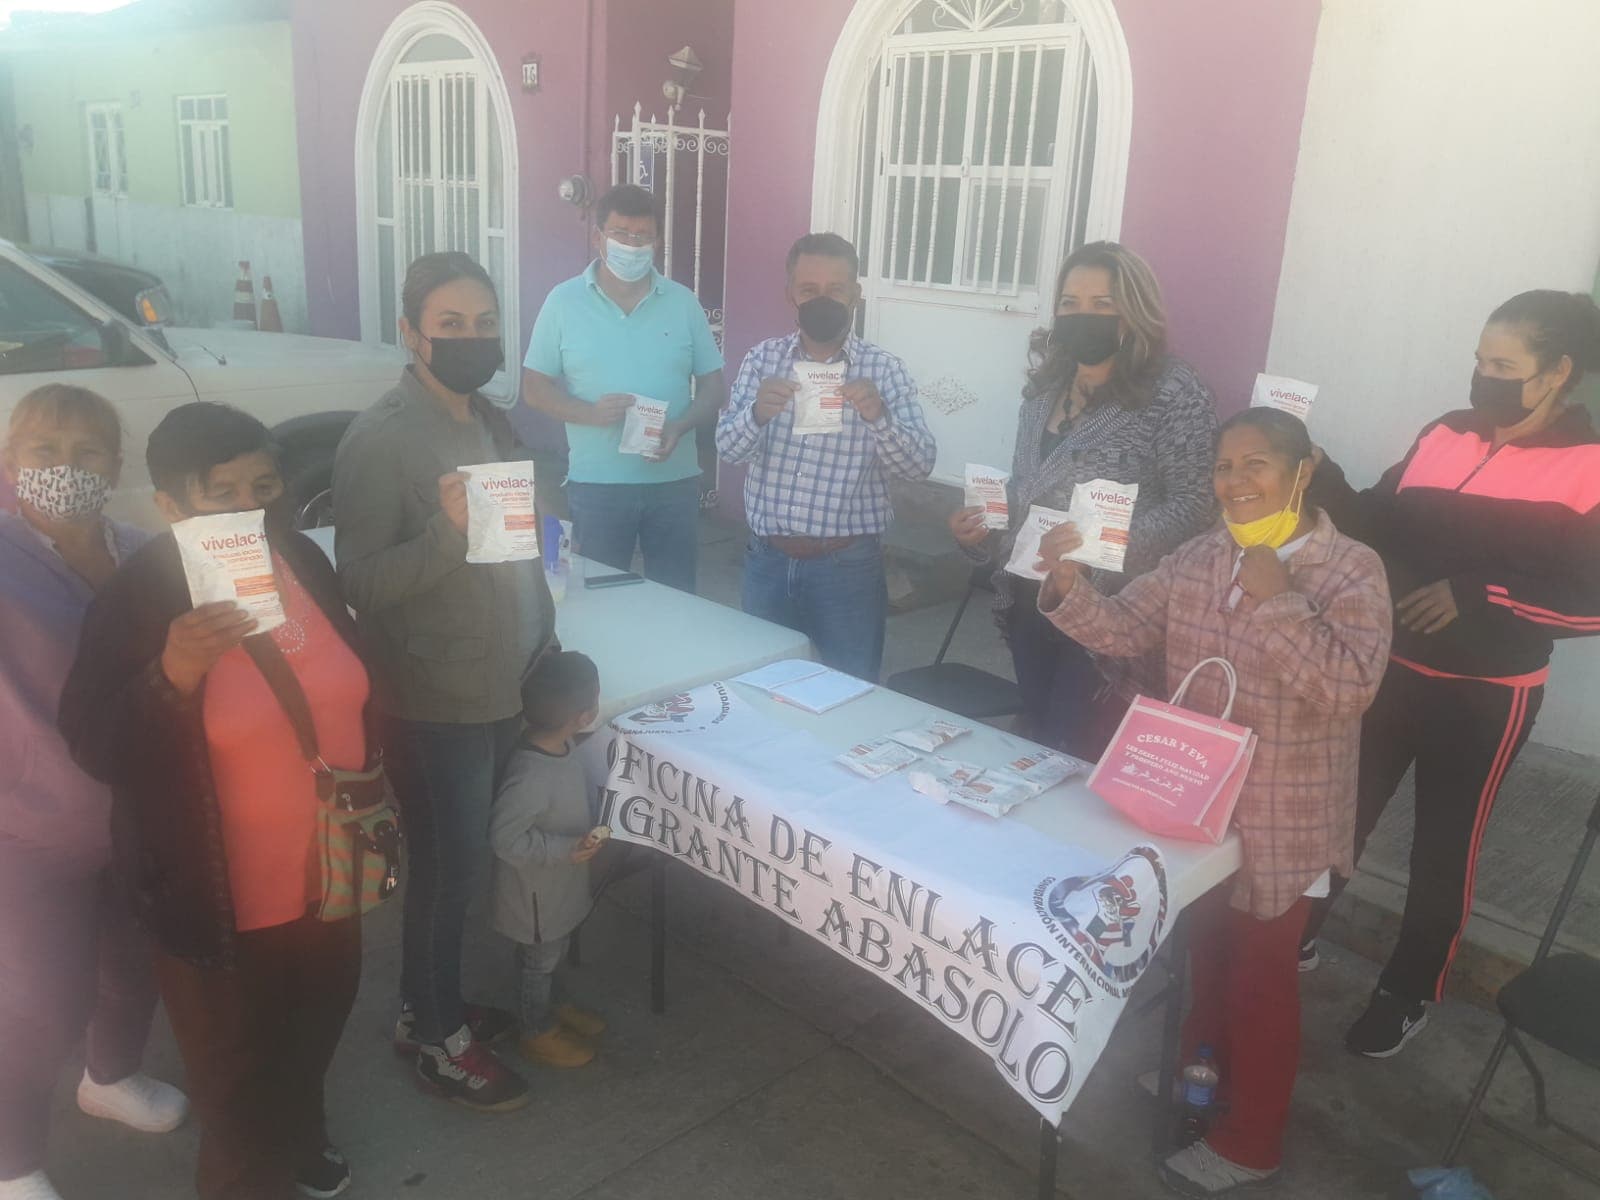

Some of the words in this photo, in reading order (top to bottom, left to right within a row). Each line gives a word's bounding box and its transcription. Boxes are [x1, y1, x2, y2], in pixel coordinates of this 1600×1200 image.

[201, 531, 268, 551] vivelac+
[1137, 734, 1177, 748] CESAR
[1179, 742, 1190, 752] Y
[1187, 748, 1209, 769] EVA
[607, 738, 756, 847] OFICINA
[768, 813, 833, 887] DE
[846, 852, 1096, 1044] ENLACE
[1055, 933, 1121, 998] INTERNACIONAL
[815, 898, 1074, 1104] ABASOLO
